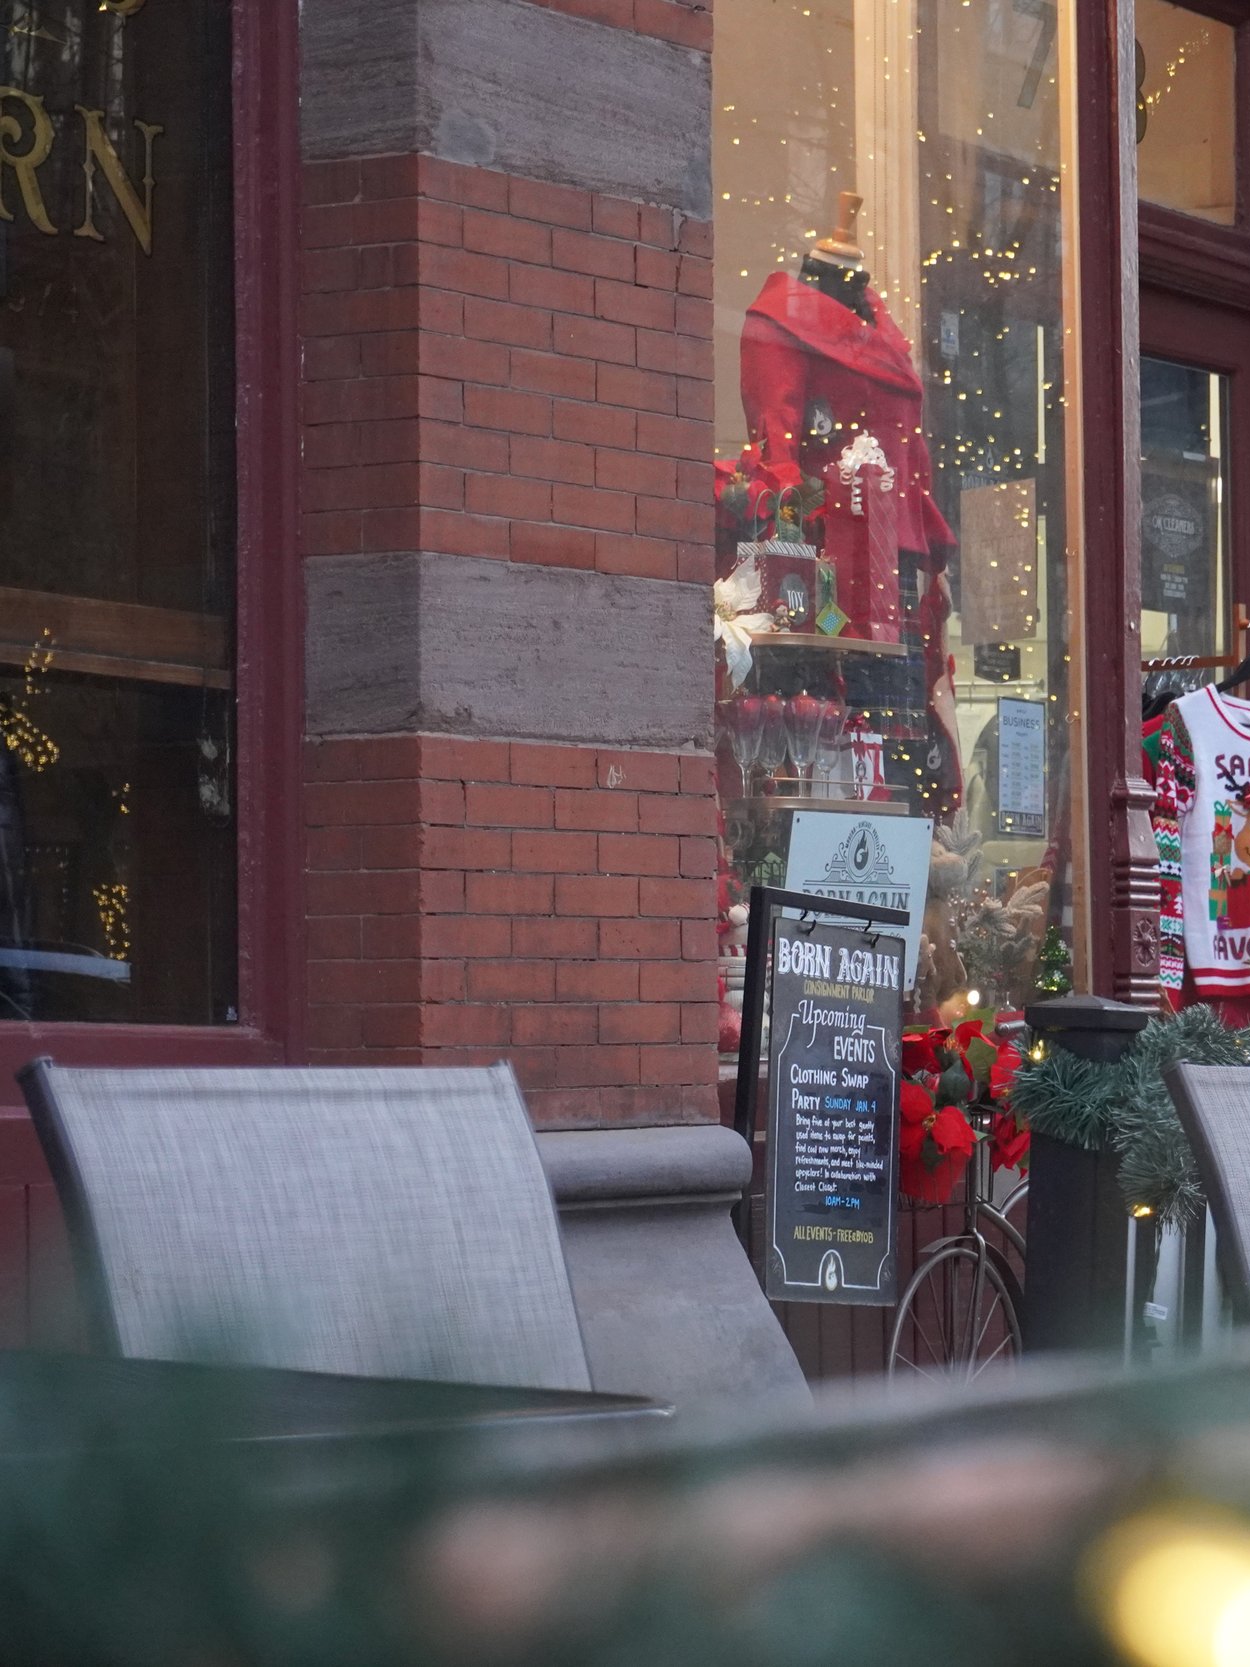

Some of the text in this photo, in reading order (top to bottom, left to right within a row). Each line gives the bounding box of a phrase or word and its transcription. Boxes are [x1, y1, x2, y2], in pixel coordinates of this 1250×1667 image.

[787, 590, 804, 611] JOY
[1003, 715, 1040, 730] BUSINESS
[778, 938, 900, 991] BORN AGAIN
[804, 980, 875, 1003] CONSIGNMENT PARLOR
[798, 1000, 866, 1048] Upcoming
[834, 1036, 875, 1063] EVENTS
[790, 1064, 869, 1089] CLOTHING SWAP
[792, 1088, 820, 1110] PARTY
[825, 1096, 851, 1111] SUNDAY
[796, 1113, 810, 1131] Bring
[812, 1115, 823, 1126] five
[832, 1119, 843, 1130] your
[845, 1118, 856, 1128] best
[796, 1130, 808, 1140] used
[810, 1129, 823, 1140] items
[824, 1130, 831, 1141] to
[848, 1131, 856, 1140] for
[795, 1141, 806, 1153] find
[807, 1145, 817, 1153] cool
[863, 1172, 877, 1182] with
